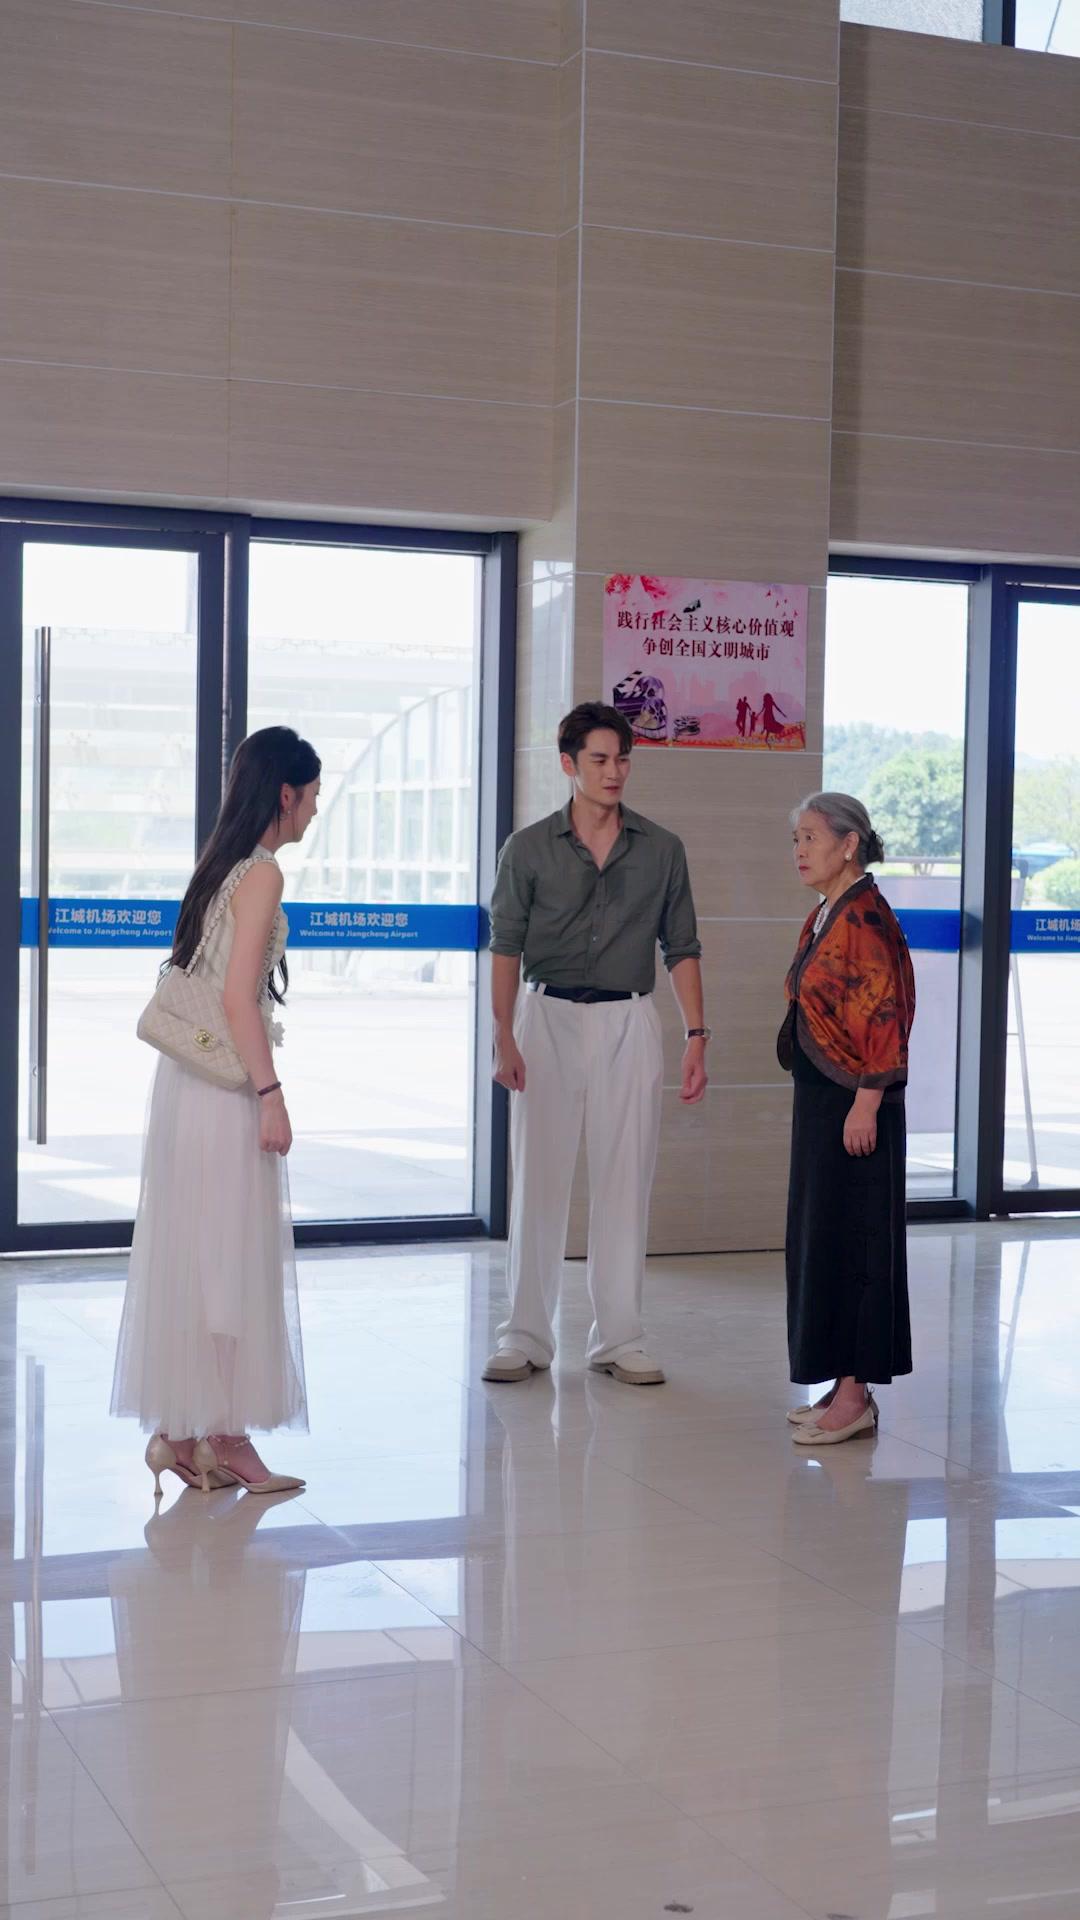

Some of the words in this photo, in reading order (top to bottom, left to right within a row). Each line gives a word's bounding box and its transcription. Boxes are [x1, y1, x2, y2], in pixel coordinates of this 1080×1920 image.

[617, 610, 795, 638] 践行社会主义核心价值观
[642, 636, 770, 661] 争创全国文明城市
[55, 907, 162, 925] 江城机场欢迎您
[310, 911, 408, 928] 江城机场欢迎您
[94, 928, 140, 938] Jiangcheng
[142, 929, 172, 938] Airport
[299, 929, 335, 937] Welcome
[346, 929, 389, 939] Jiangcheng
[390, 930, 418, 939] Airport
